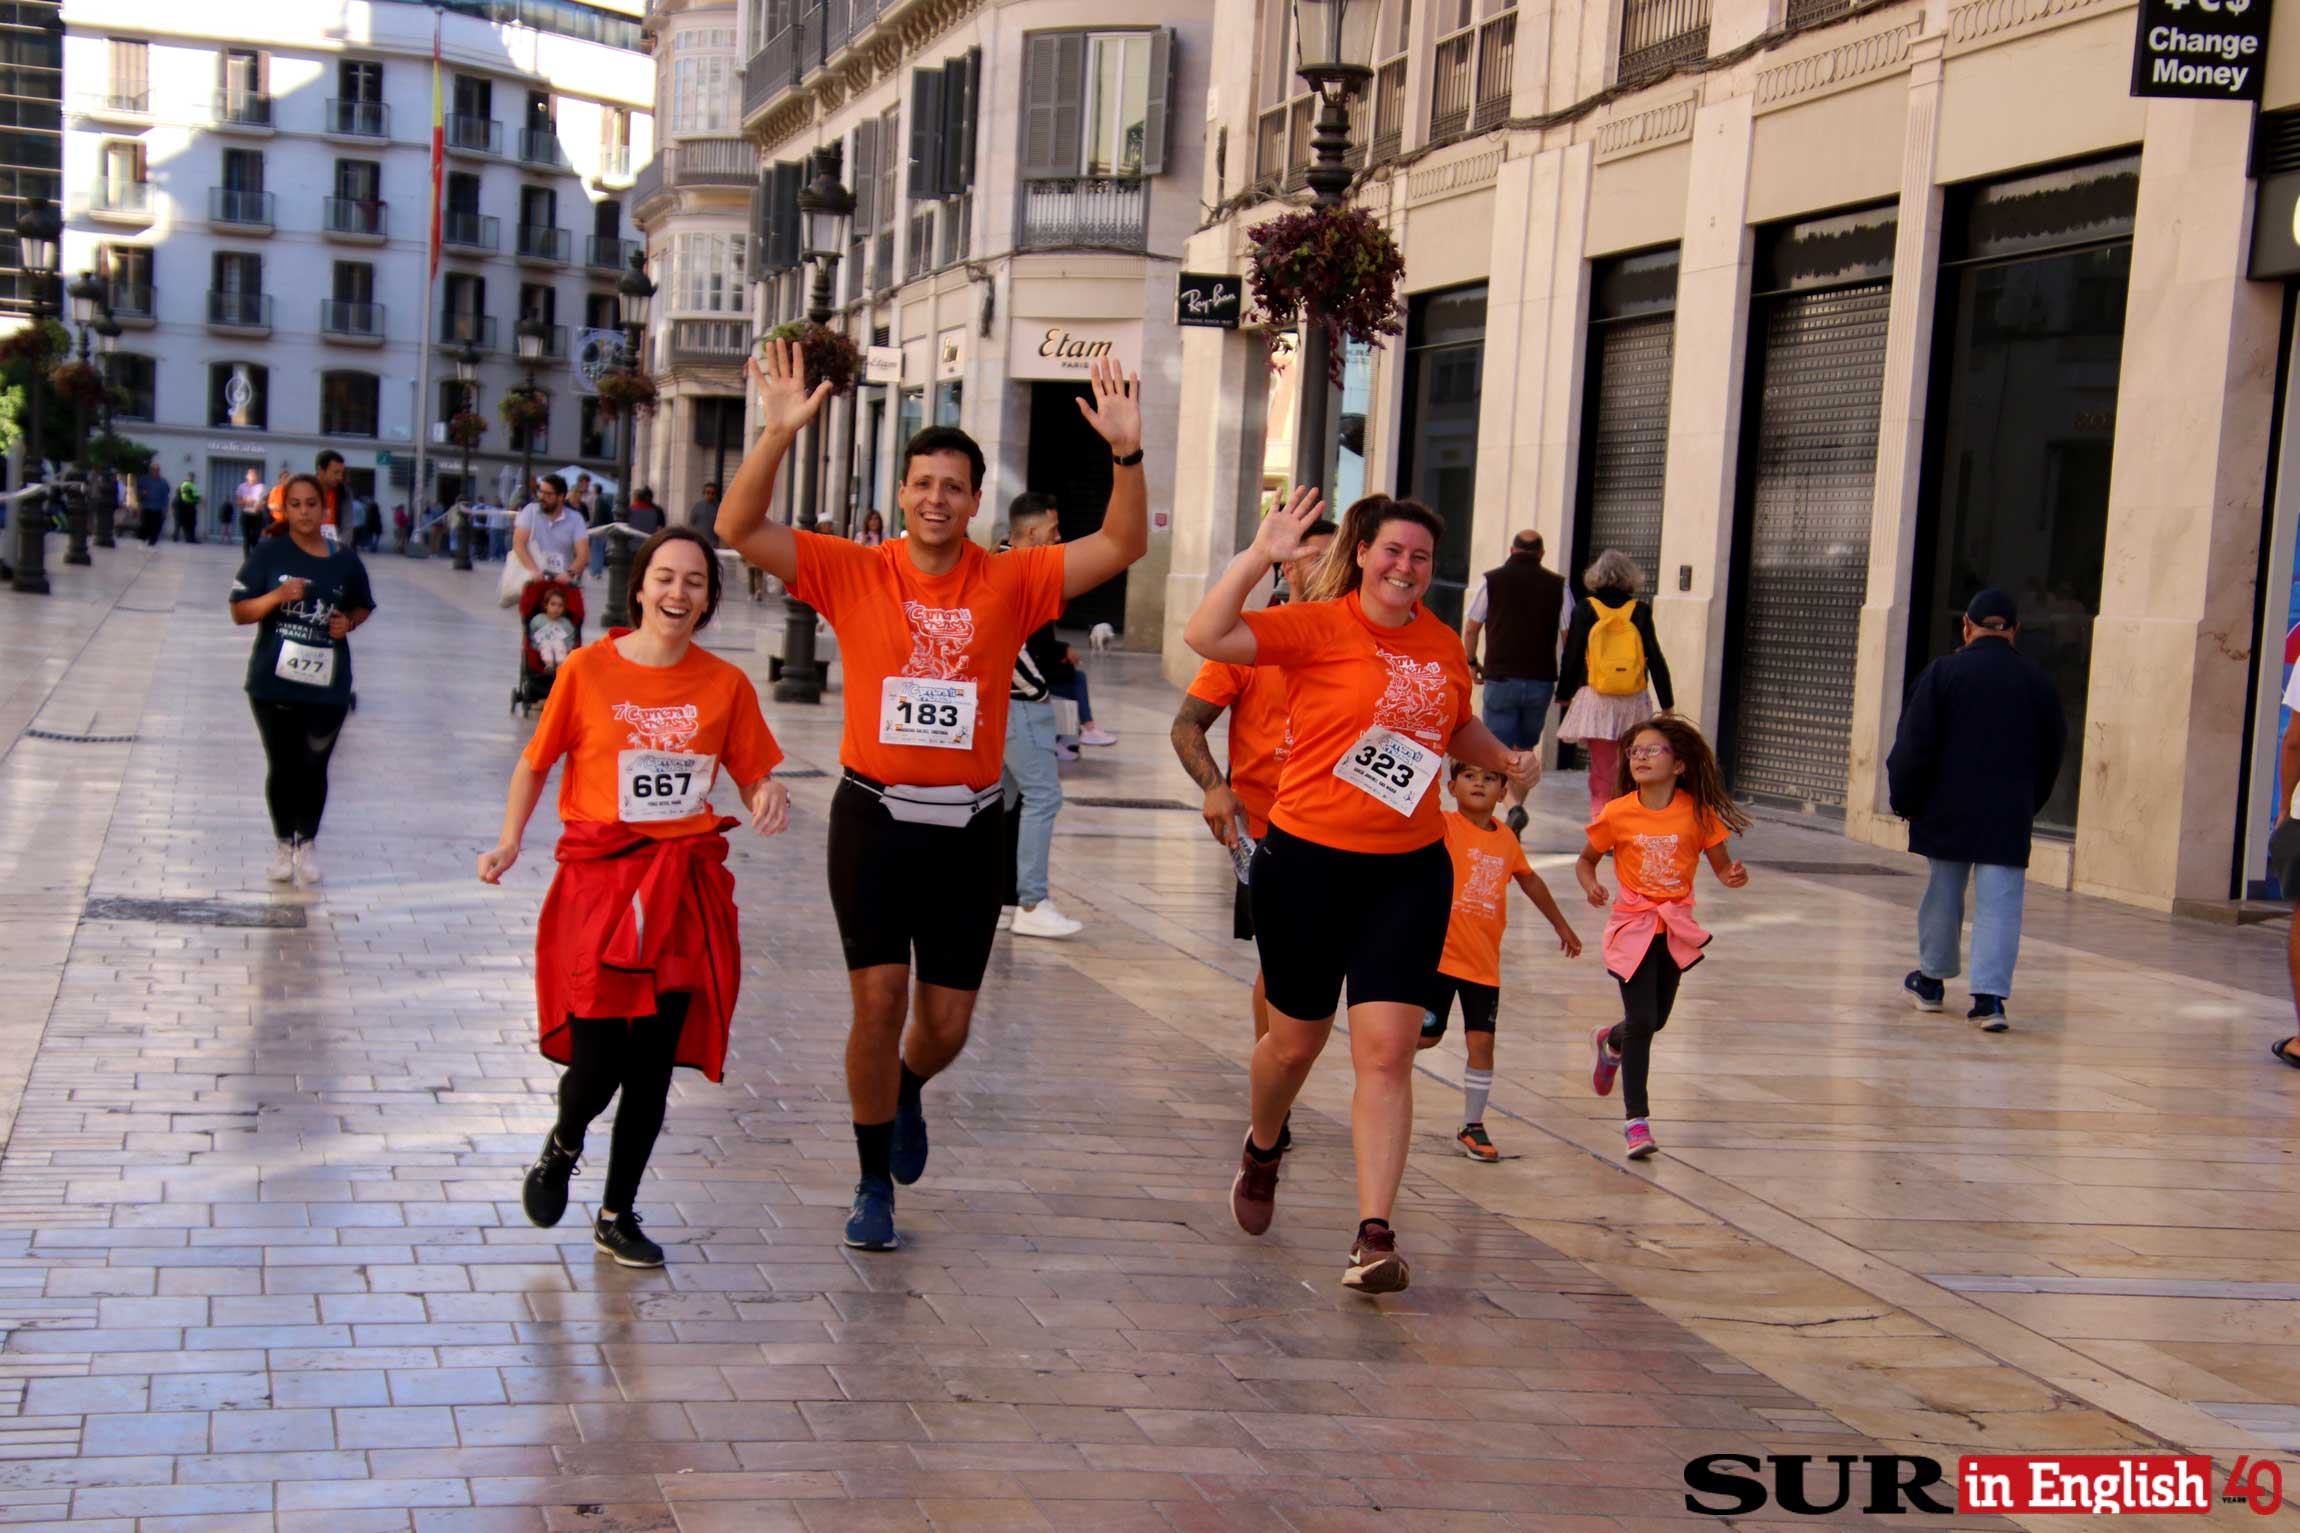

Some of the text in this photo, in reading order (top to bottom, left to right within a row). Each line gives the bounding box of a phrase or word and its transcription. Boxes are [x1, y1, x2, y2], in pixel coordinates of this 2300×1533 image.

[2149, 26, 2258, 59] Change
[2152, 58, 2248, 91] Money
[1180, 283, 1236, 313] Ray-Ban
[1038, 328, 1112, 358] Etam
[1061, 361, 1090, 369] PARIS
[287, 657, 324, 674] 477
[897, 702, 958, 727] 183
[1355, 745, 1415, 789] 323
[633, 773, 692, 797] 667
